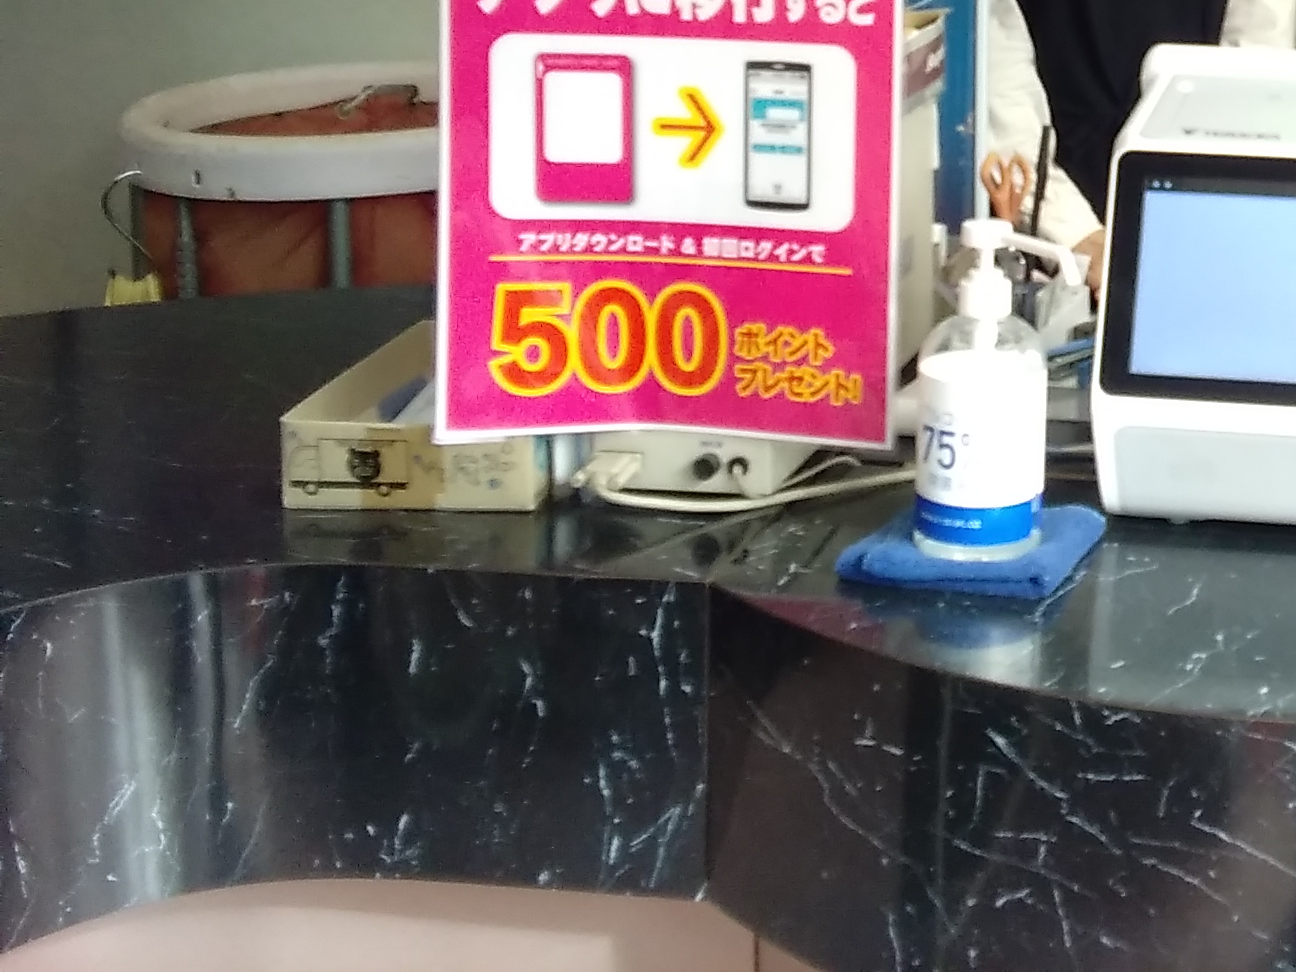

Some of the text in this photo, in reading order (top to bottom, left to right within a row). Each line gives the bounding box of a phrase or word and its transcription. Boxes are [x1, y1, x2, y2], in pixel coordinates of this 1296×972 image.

[517, 232, 676, 256] アプリダウンロード
[679, 236, 697, 256] &
[490, 280, 727, 397] 500
[736, 325, 833, 365] ポイント
